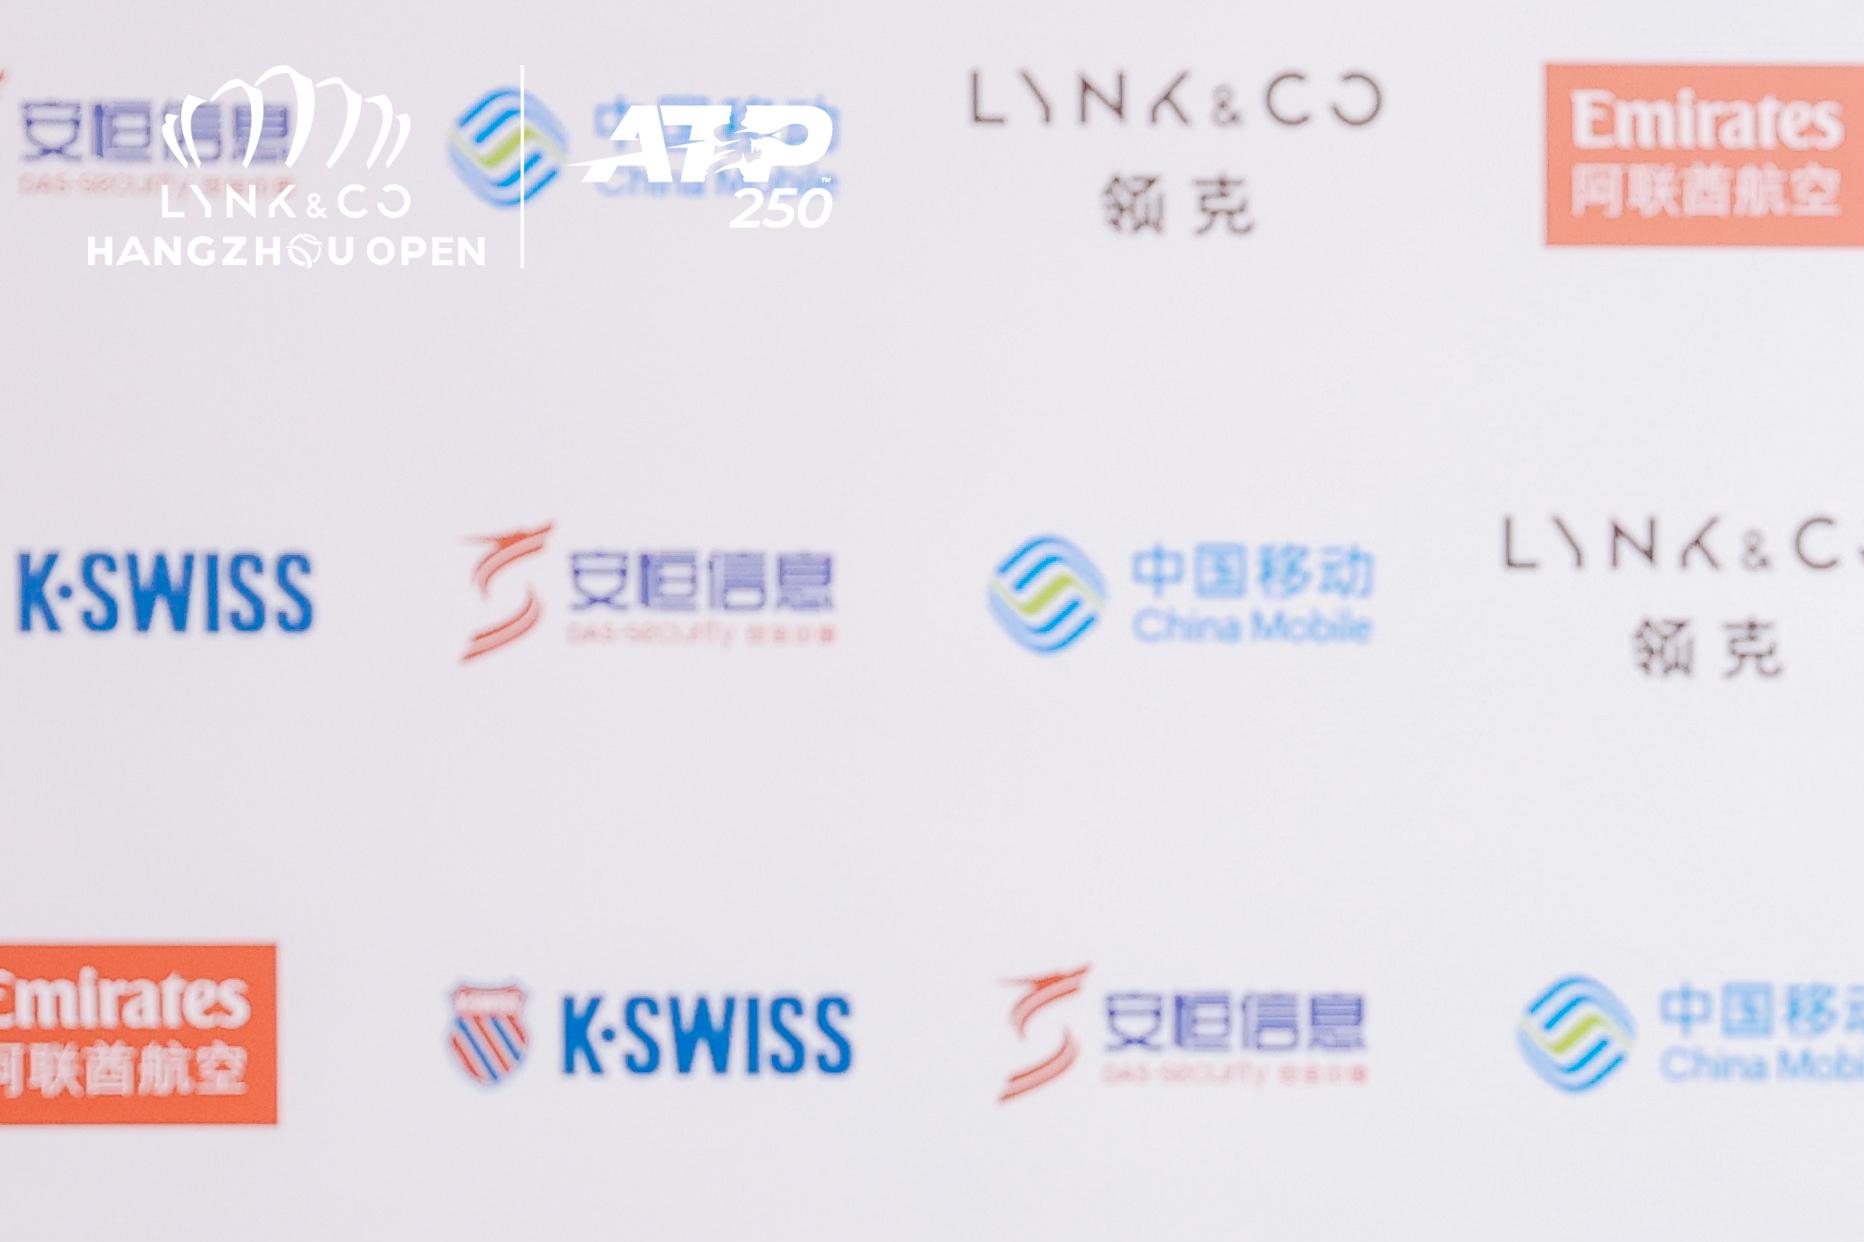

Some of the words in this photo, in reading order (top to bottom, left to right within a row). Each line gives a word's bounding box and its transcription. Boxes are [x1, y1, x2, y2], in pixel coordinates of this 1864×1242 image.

[1571, 87, 1844, 150] Emirates
[1102, 174, 1254, 235] 领克
[1572, 161, 1841, 218] 阿联酋航空
[569, 551, 833, 612] 安恒信息
[1132, 543, 1374, 599] 中国移动
[1132, 607, 1244, 644] China
[1250, 609, 1373, 644] Mobile
[1633, 618, 1783, 678] 领克
[1105, 991, 1365, 1052] 安恒信息
[1660, 1046, 1770, 1082] China
